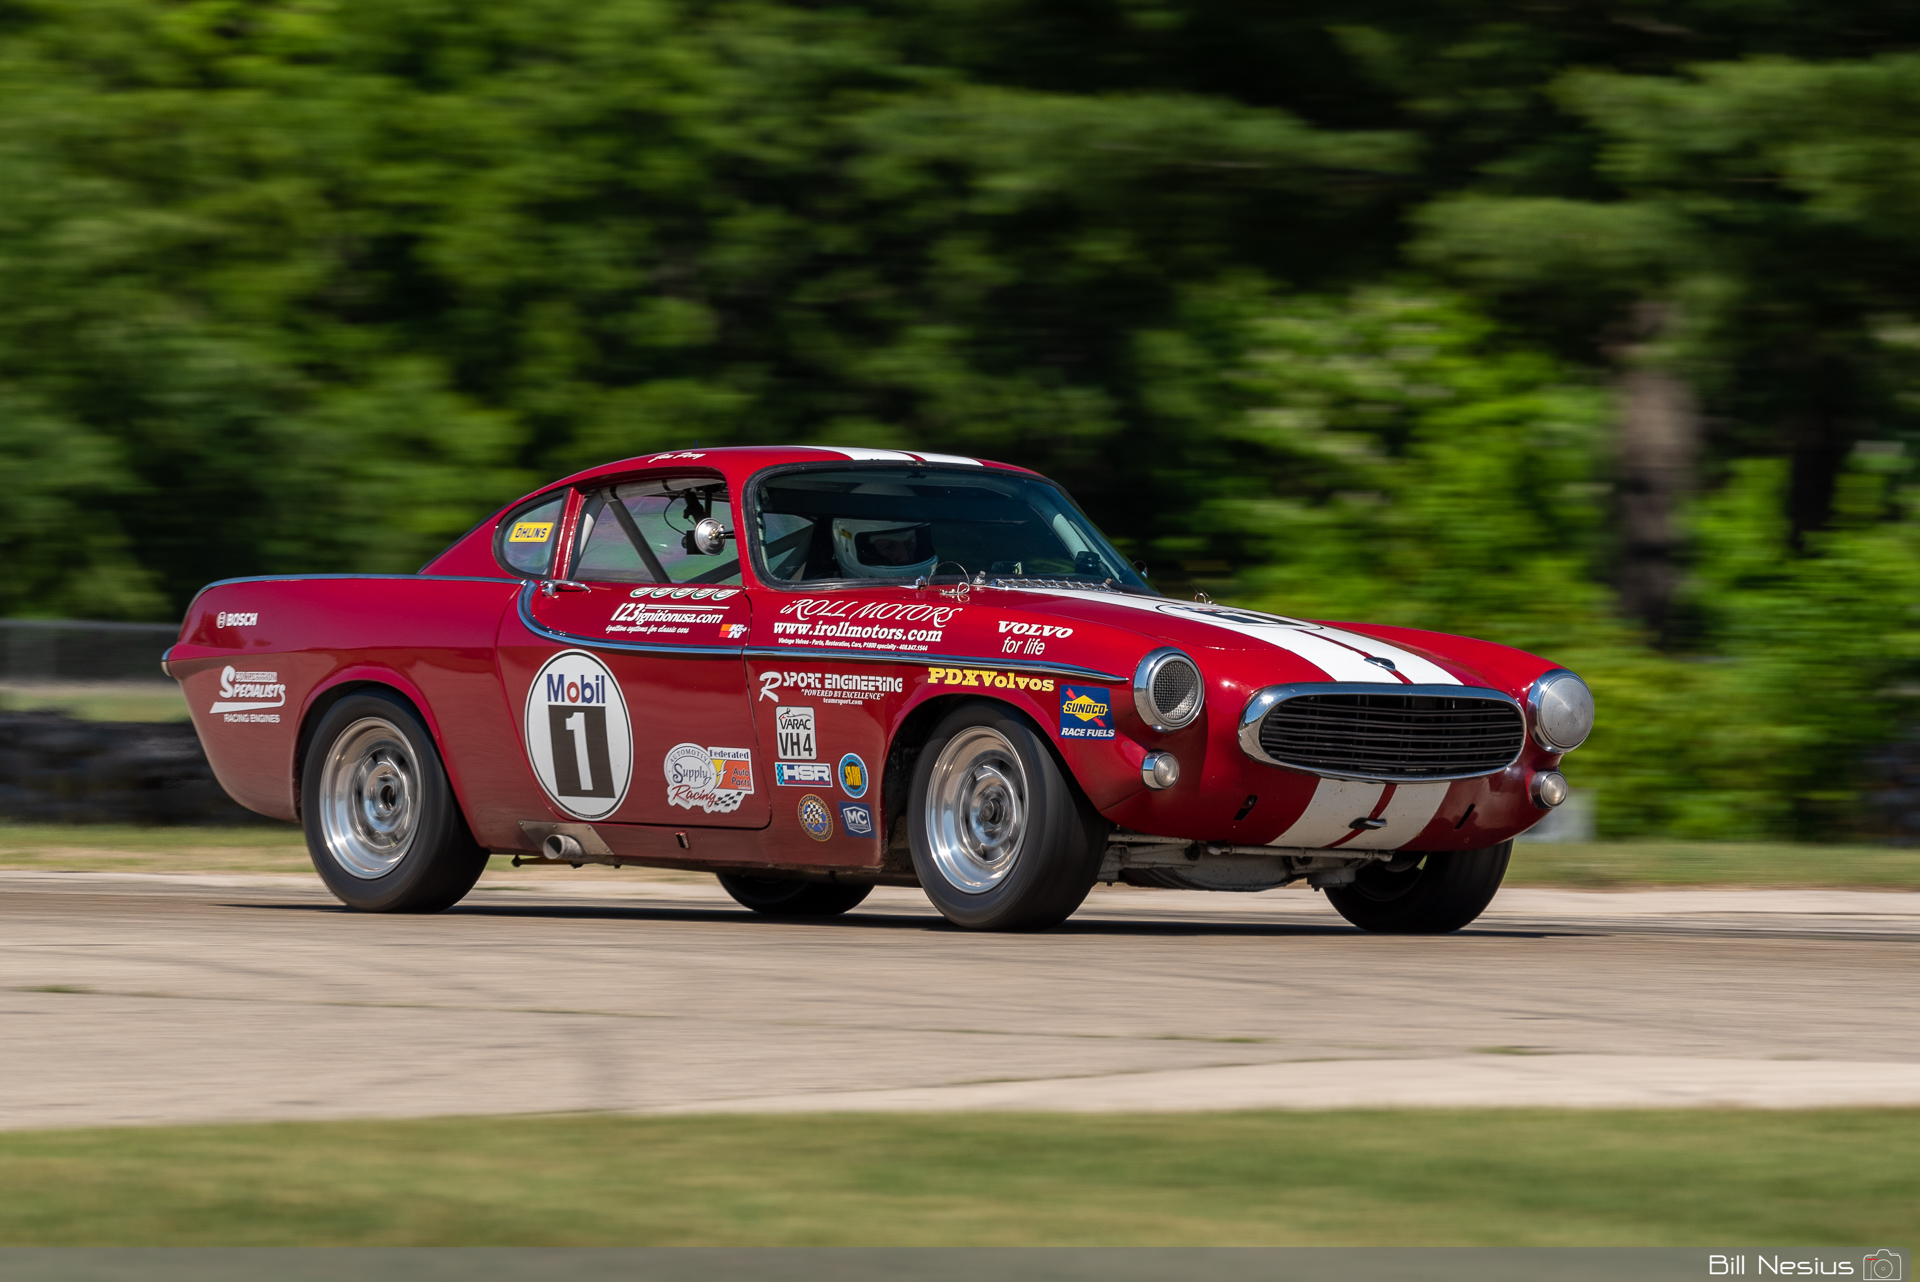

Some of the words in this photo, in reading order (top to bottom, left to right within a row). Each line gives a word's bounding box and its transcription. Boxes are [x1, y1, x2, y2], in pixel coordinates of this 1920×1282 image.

[515, 525, 547, 538] ÖHLINS
[226, 612, 258, 626] BOSCH
[610, 603, 723, 625] 123ignitionusa.com
[849, 601, 963, 628] MOTORS
[773, 620, 942, 642] www.irollmotors.com
[998, 620, 1074, 638] VOLVO
[1001, 636, 1023, 653] for
[1023, 638, 1046, 655] life
[219, 665, 286, 701] SPECIALISTS
[546, 673, 606, 703] Mobil
[759, 671, 782, 702] R
[783, 671, 822, 688] SPORT
[927, 667, 1055, 692] PDXVolvos
[833, 690, 842, 698] BY
[1064, 702, 1106, 715] SUNOCO
[224, 713, 249, 722] RACING
[250, 714, 280, 723] ENGINES
[779, 718, 811, 730] VARAC
[1061, 727, 1085, 737] RACE
[1087, 728, 1115, 738] FUELS
[565, 712, 593, 790] 1
[779, 732, 813, 757] VH4
[670, 748, 712, 765] AUTOMOTIVE
[709, 749, 749, 760] Federated
[672, 763, 712, 785] Supply
[732, 766, 749, 777] Auto
[782, 764, 830, 781] HSR
[731, 777, 750, 787] Parts
[671, 784, 718, 807] Racing
[847, 810, 867, 825] MC
